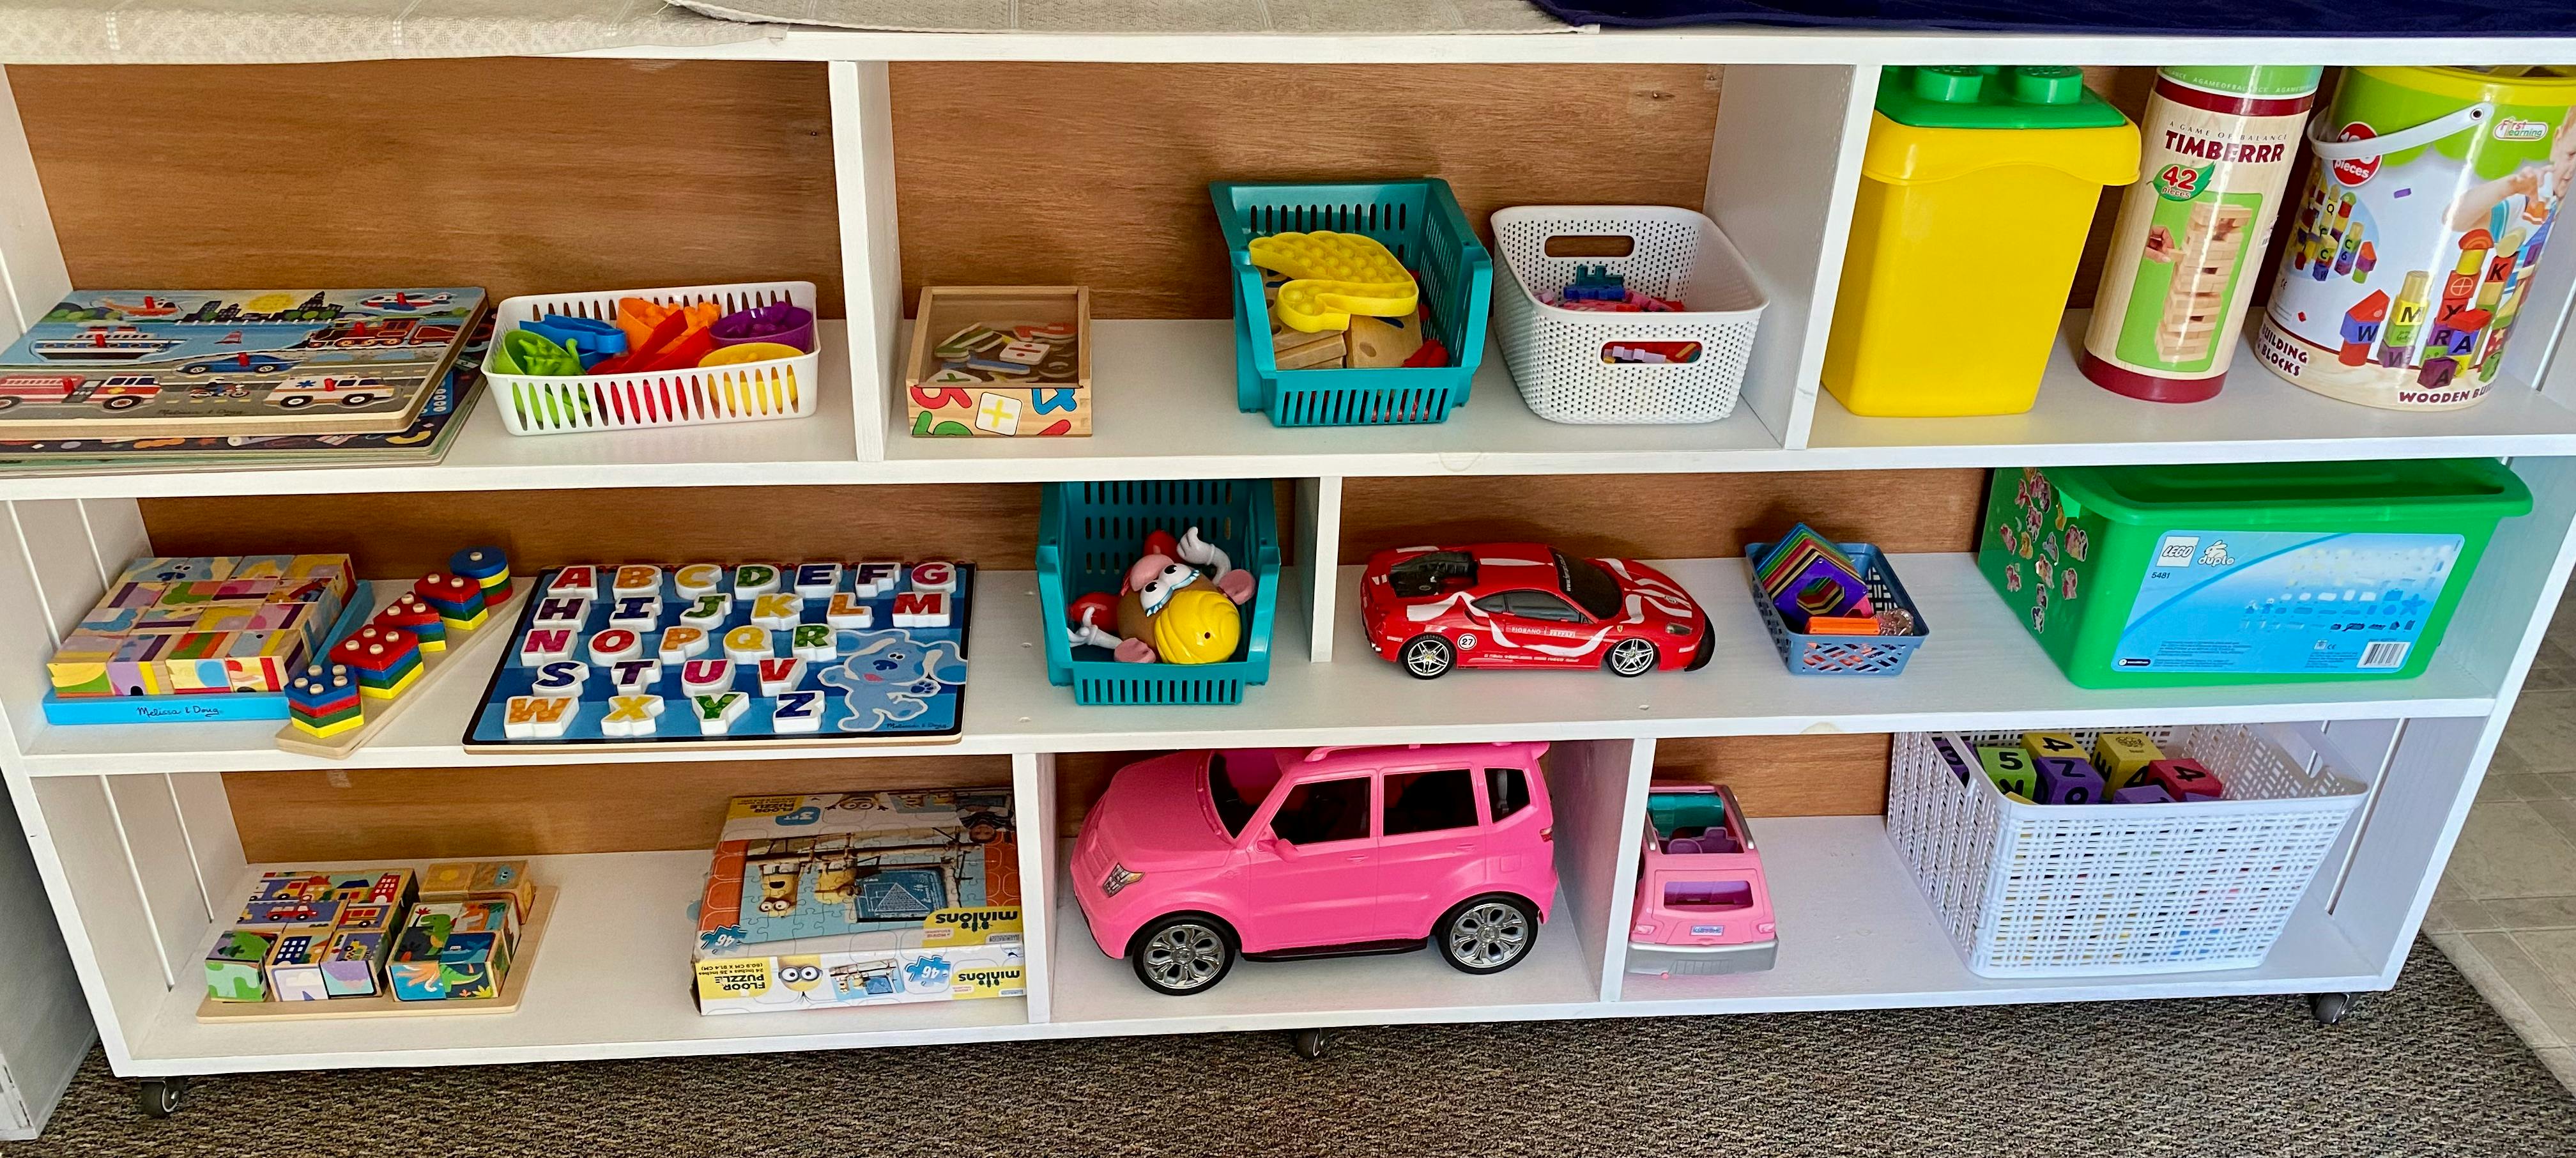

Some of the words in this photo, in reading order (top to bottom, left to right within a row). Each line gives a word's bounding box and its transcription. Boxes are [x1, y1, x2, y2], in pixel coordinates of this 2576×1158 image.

[2193, 77, 2269, 93] AGAMEOFBALCE
[2180, 124, 2211, 136] GAME
[2165, 130, 2286, 163] TIMBERRR
[2334, 158, 2370, 178] pieces
[2163, 166, 2198, 191] 42
[2161, 186, 2191, 199] pieces
[2488, 262, 2508, 281] K
[2400, 306, 2426, 323] M
[2357, 325, 2379, 342] W
[2433, 329, 2451, 346] R
[2262, 323, 2308, 364] BUILDING
[2452, 335, 2472, 354] A
[2261, 343, 2301, 376] BLOCKS
[2434, 367, 2449, 383] A
[2399, 390, 2470, 403] WOODEN
[2161, 545, 2194, 558] LEGO
[2198, 555, 2235, 567] duplo
[551, 567, 592, 588] A
[616, 567, 656, 588] B
[677, 566, 720, 587] C
[739, 566, 774, 587] D
[797, 564, 836, 585] E
[857, 564, 896, 585] F
[912, 564, 949, 585] G
[537, 598, 584, 621] H
[613, 596, 656, 619] I
[683, 595, 726, 619] J
[754, 594, 796, 618] K
[829, 593, 864, 615] L
[894, 593, 942, 615] M
[524, 629, 572, 652] N
[592, 629, 636, 654] O
[661, 628, 702, 651] P
[724, 626, 766, 650] Q
[793, 624, 831, 648] R
[1461, 638, 1474, 646] 27
[535, 662, 581, 688] S
[614, 660, 655, 685] T
[684, 660, 728, 684] U
[759, 658, 798, 682] V
[136, 707, 181, 718] Melissa
[192, 706, 220, 718] Doug
[509, 697, 573, 724] W
[606, 696, 653, 722] X
[695, 693, 741, 720] Y
[775, 692, 815, 718] Z
[2042, 737, 2074, 752] 4
[1998, 751, 2023, 771] 5
[2172, 766, 2207, 782] 4
[935, 911, 1018, 930] minions
[715, 934, 735, 947] 46
[714, 974, 765, 984] PUZZLE
[921, 966, 940, 979] 46
[958, 970, 1020, 987] minions
[723, 982, 766, 991] FLOOR
